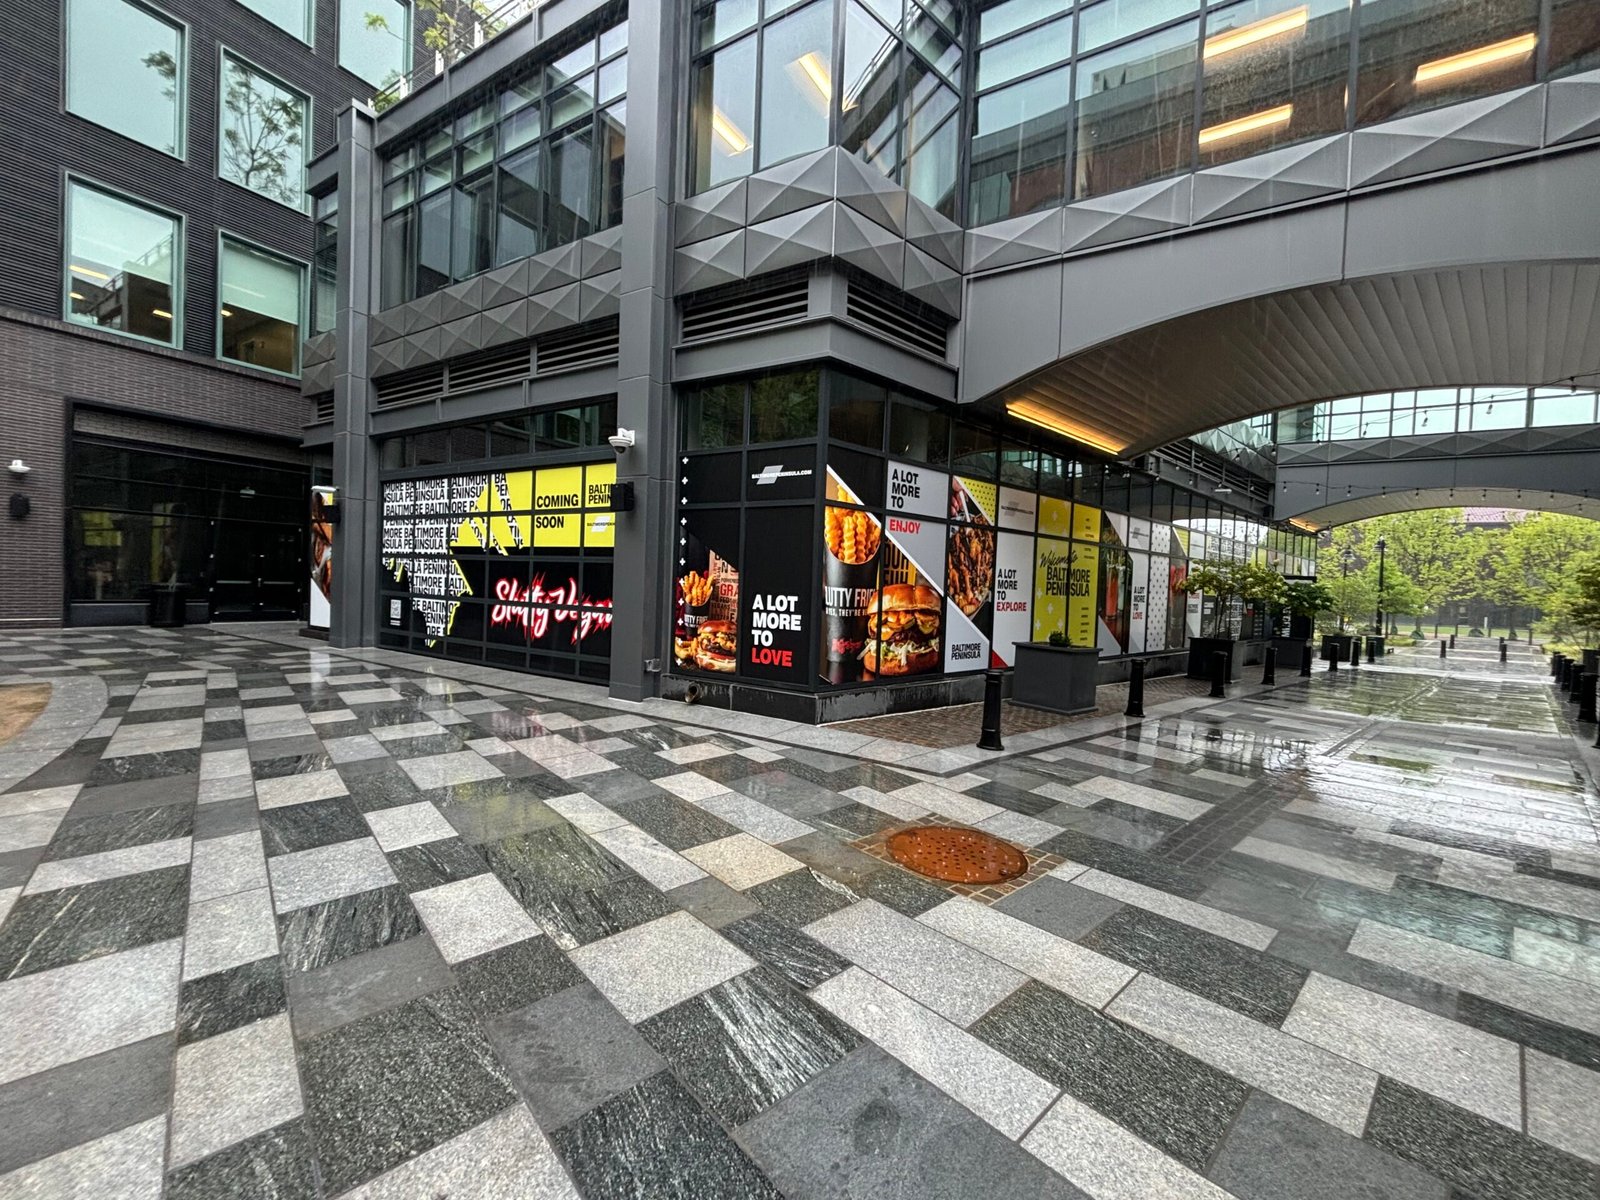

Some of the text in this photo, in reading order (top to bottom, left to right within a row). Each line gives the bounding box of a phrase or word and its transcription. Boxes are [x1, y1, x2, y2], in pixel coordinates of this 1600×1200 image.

[892, 468, 918, 484] A LOT
[892, 482, 920, 498] MORE
[536, 494, 579, 508] COMING
[891, 496, 904, 508] TO
[535, 516, 564, 528] SOON
[890, 519, 920, 534] ENJOY
[998, 568, 1016, 579] A LOT
[1046, 566, 1090, 582] BALTMORE
[998, 580, 1018, 590] MORE
[1046, 582, 1090, 597] PENISULA
[997, 590, 1006, 600] TO
[752, 594, 798, 612] A LOT
[996, 602, 1027, 612] EXPLORE
[752, 612, 802, 631] MORE
[1132, 612, 1143, 620] LOVE
[752, 630, 774, 647] TO
[952, 643, 980, 652] BALTIMORE
[752, 647, 792, 667] LOVE
[952, 651, 980, 660] PENINSULA
